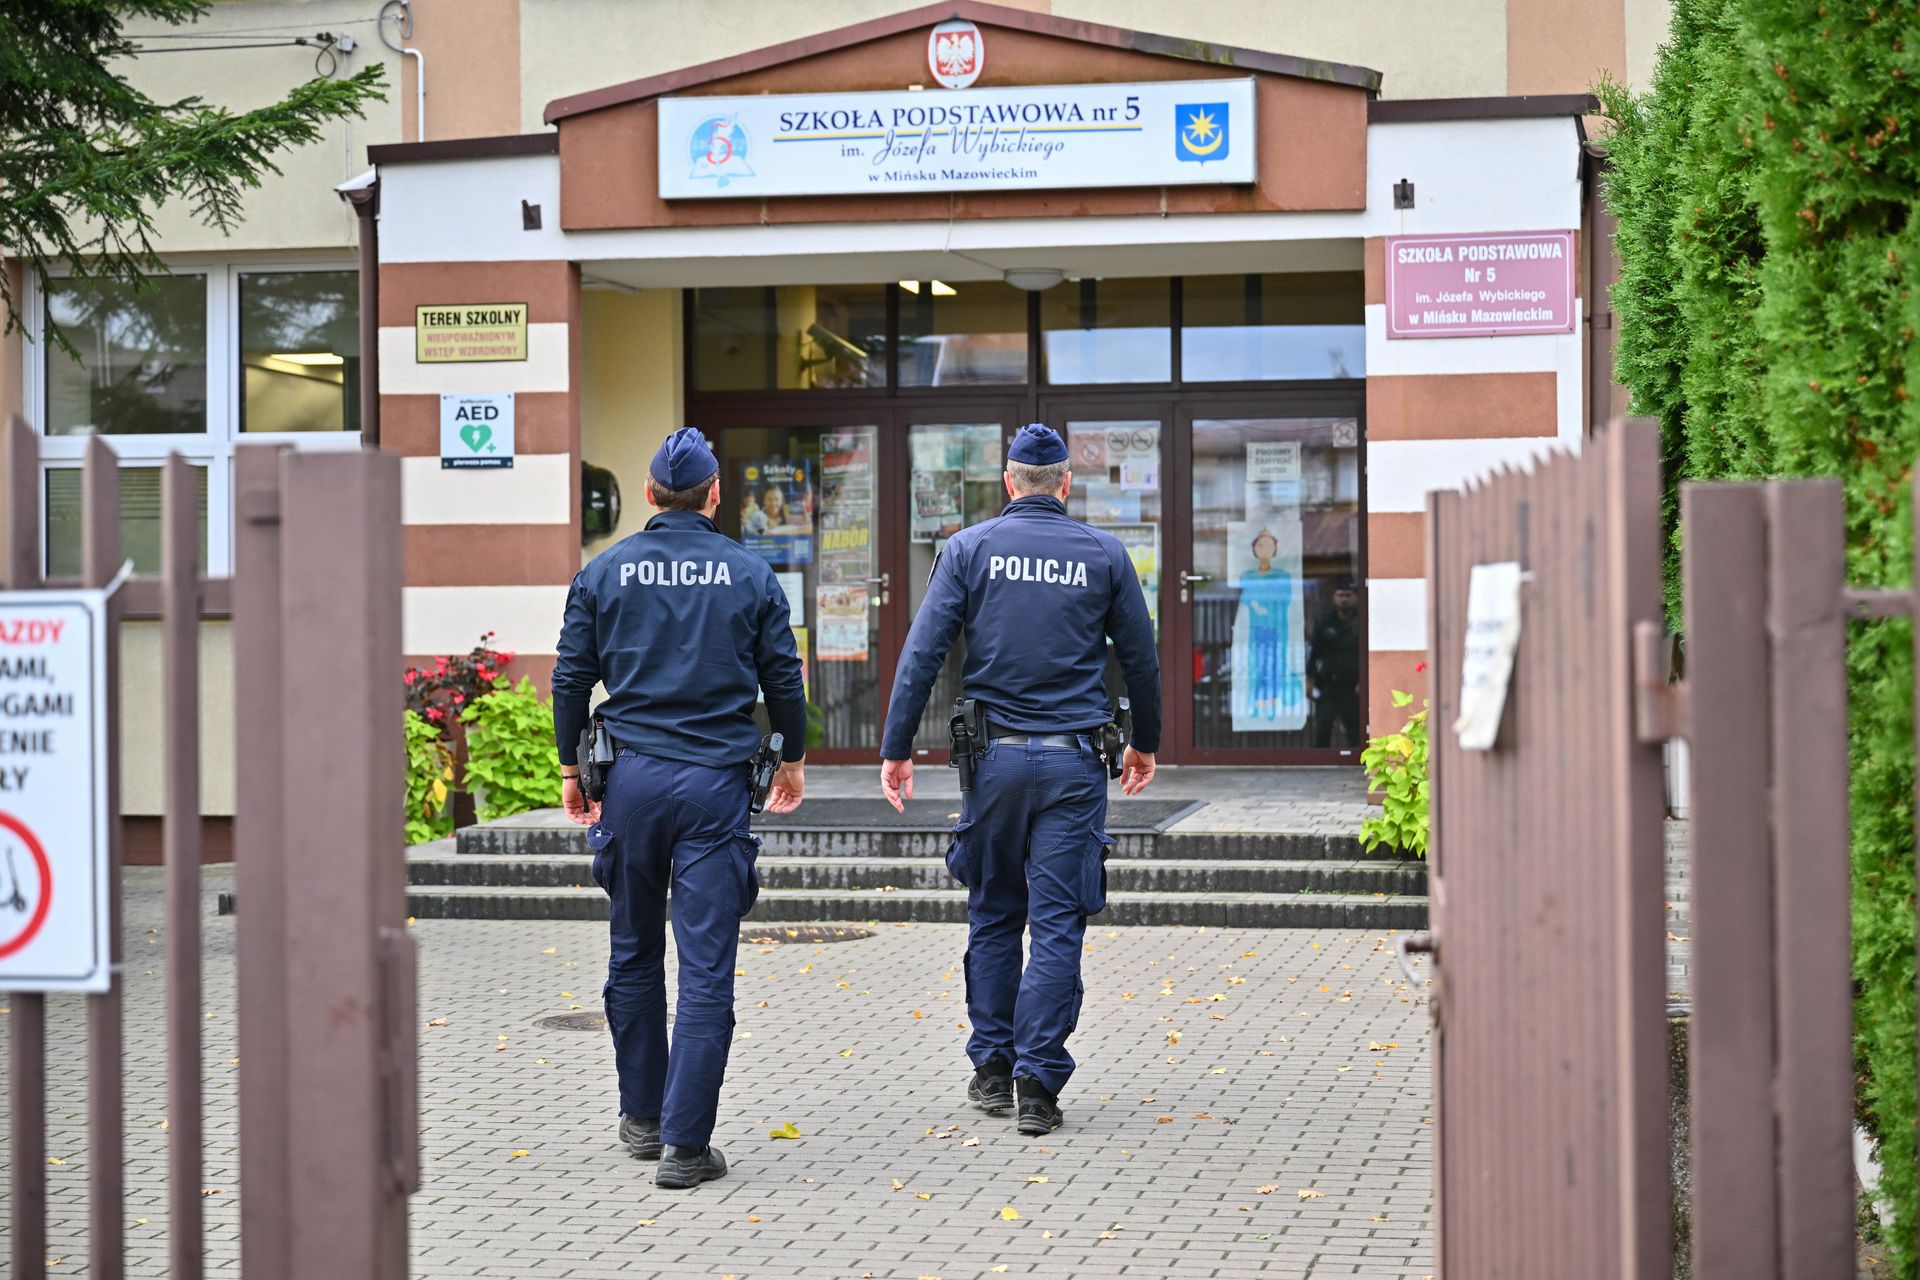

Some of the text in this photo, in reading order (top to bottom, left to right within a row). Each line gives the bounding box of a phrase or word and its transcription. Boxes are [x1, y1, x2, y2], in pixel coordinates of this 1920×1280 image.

[780, 96, 1140, 132] SZKOŁA PODSTAWOWA nr 5
[841, 126, 1065, 166] im. Józefa Wybickiego
[868, 167, 1038, 182] w Mińsku Mazowieckim
[1398, 242, 1563, 264] SZKOŁA PODSTAWOWA
[1464, 267, 1496, 283] Nr 5
[1415, 288, 1546, 304] im. Józefa Wybickiego
[422, 310, 521, 327] TEREN SZKOLNY
[1409, 306, 1553, 325] w Mińsku Mazowieckim
[426, 330, 517, 343] NIEUPOWAŻNIONYM
[424, 344, 518, 359] WSTĘP WZBRONIONY
[455, 405, 499, 421] AED
[620, 560, 732, 587] POLICJA
[990, 555, 1088, 587] POLICJA
[0, 692, 74, 718] GAMI
